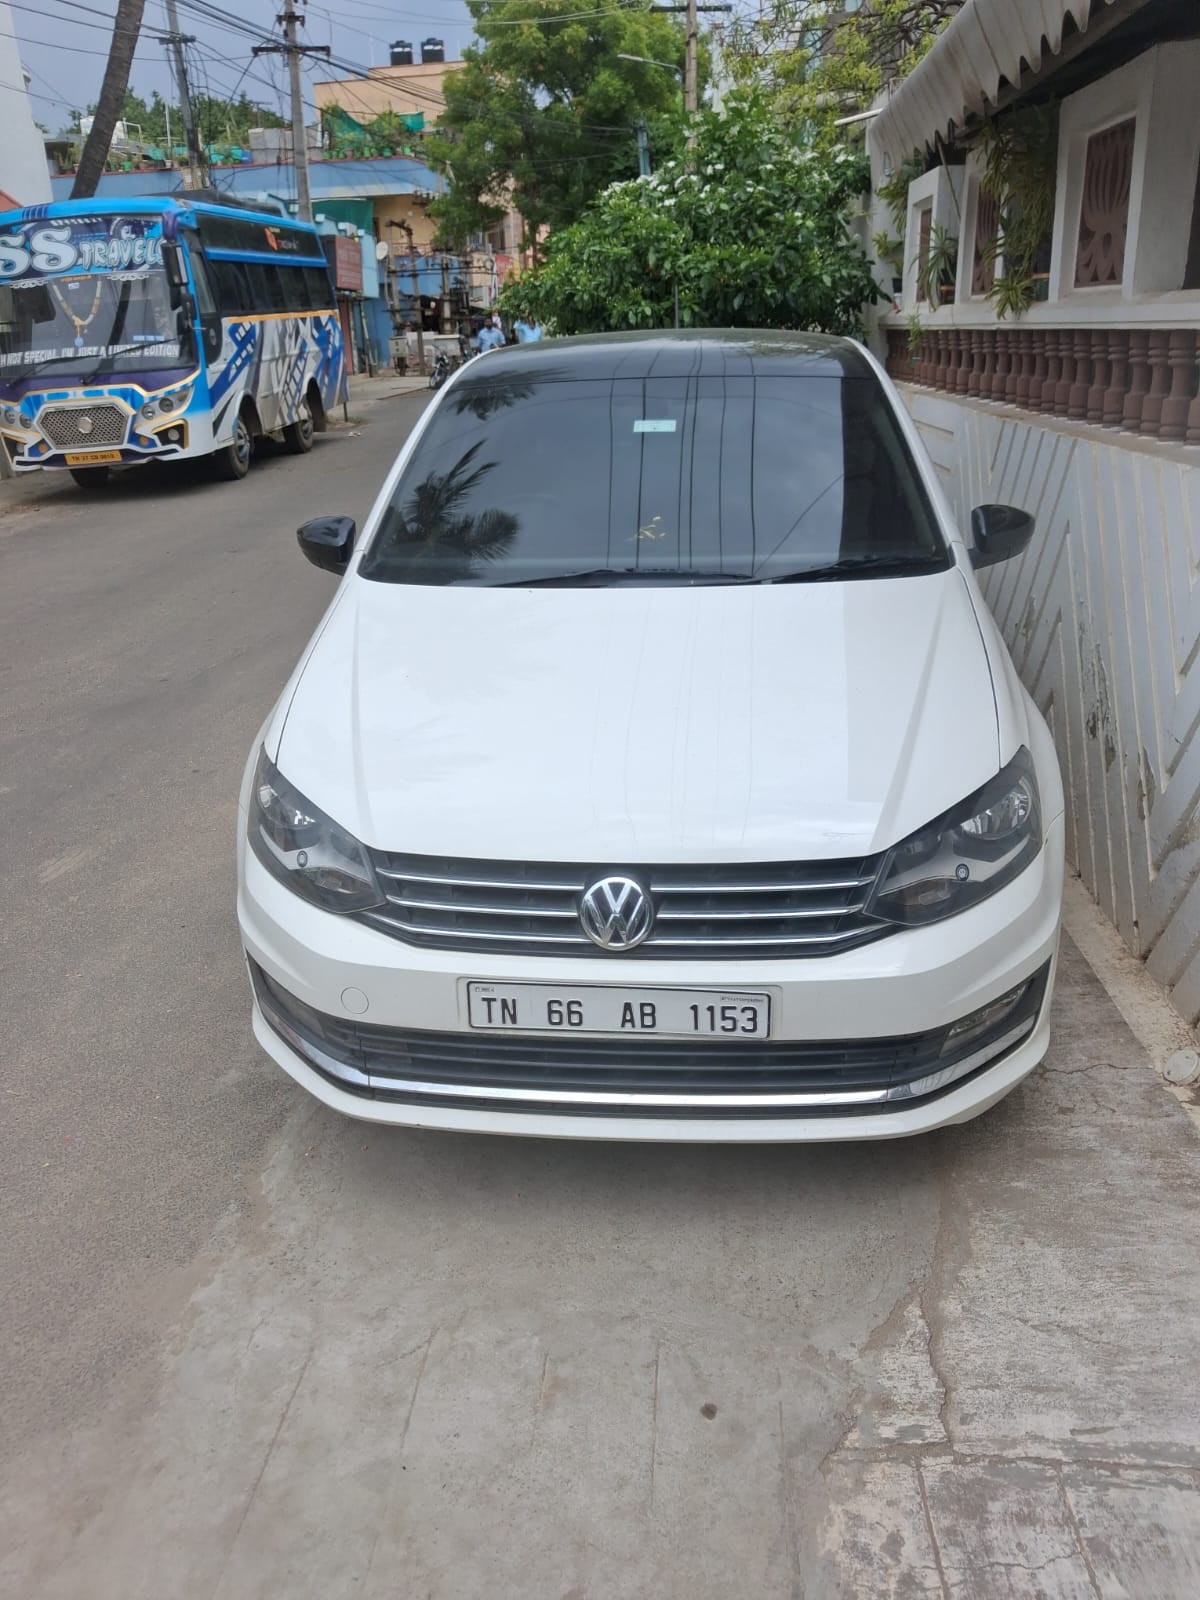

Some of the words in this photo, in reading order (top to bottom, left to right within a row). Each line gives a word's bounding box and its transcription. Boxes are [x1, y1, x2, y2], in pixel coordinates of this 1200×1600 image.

[143, 344, 180, 358] EDITION
[481, 997, 517, 1025] TN
[547, 999, 583, 1027] 66
[620, 1002, 657, 1029] AB
[689, 1004, 758, 1033] 1153
